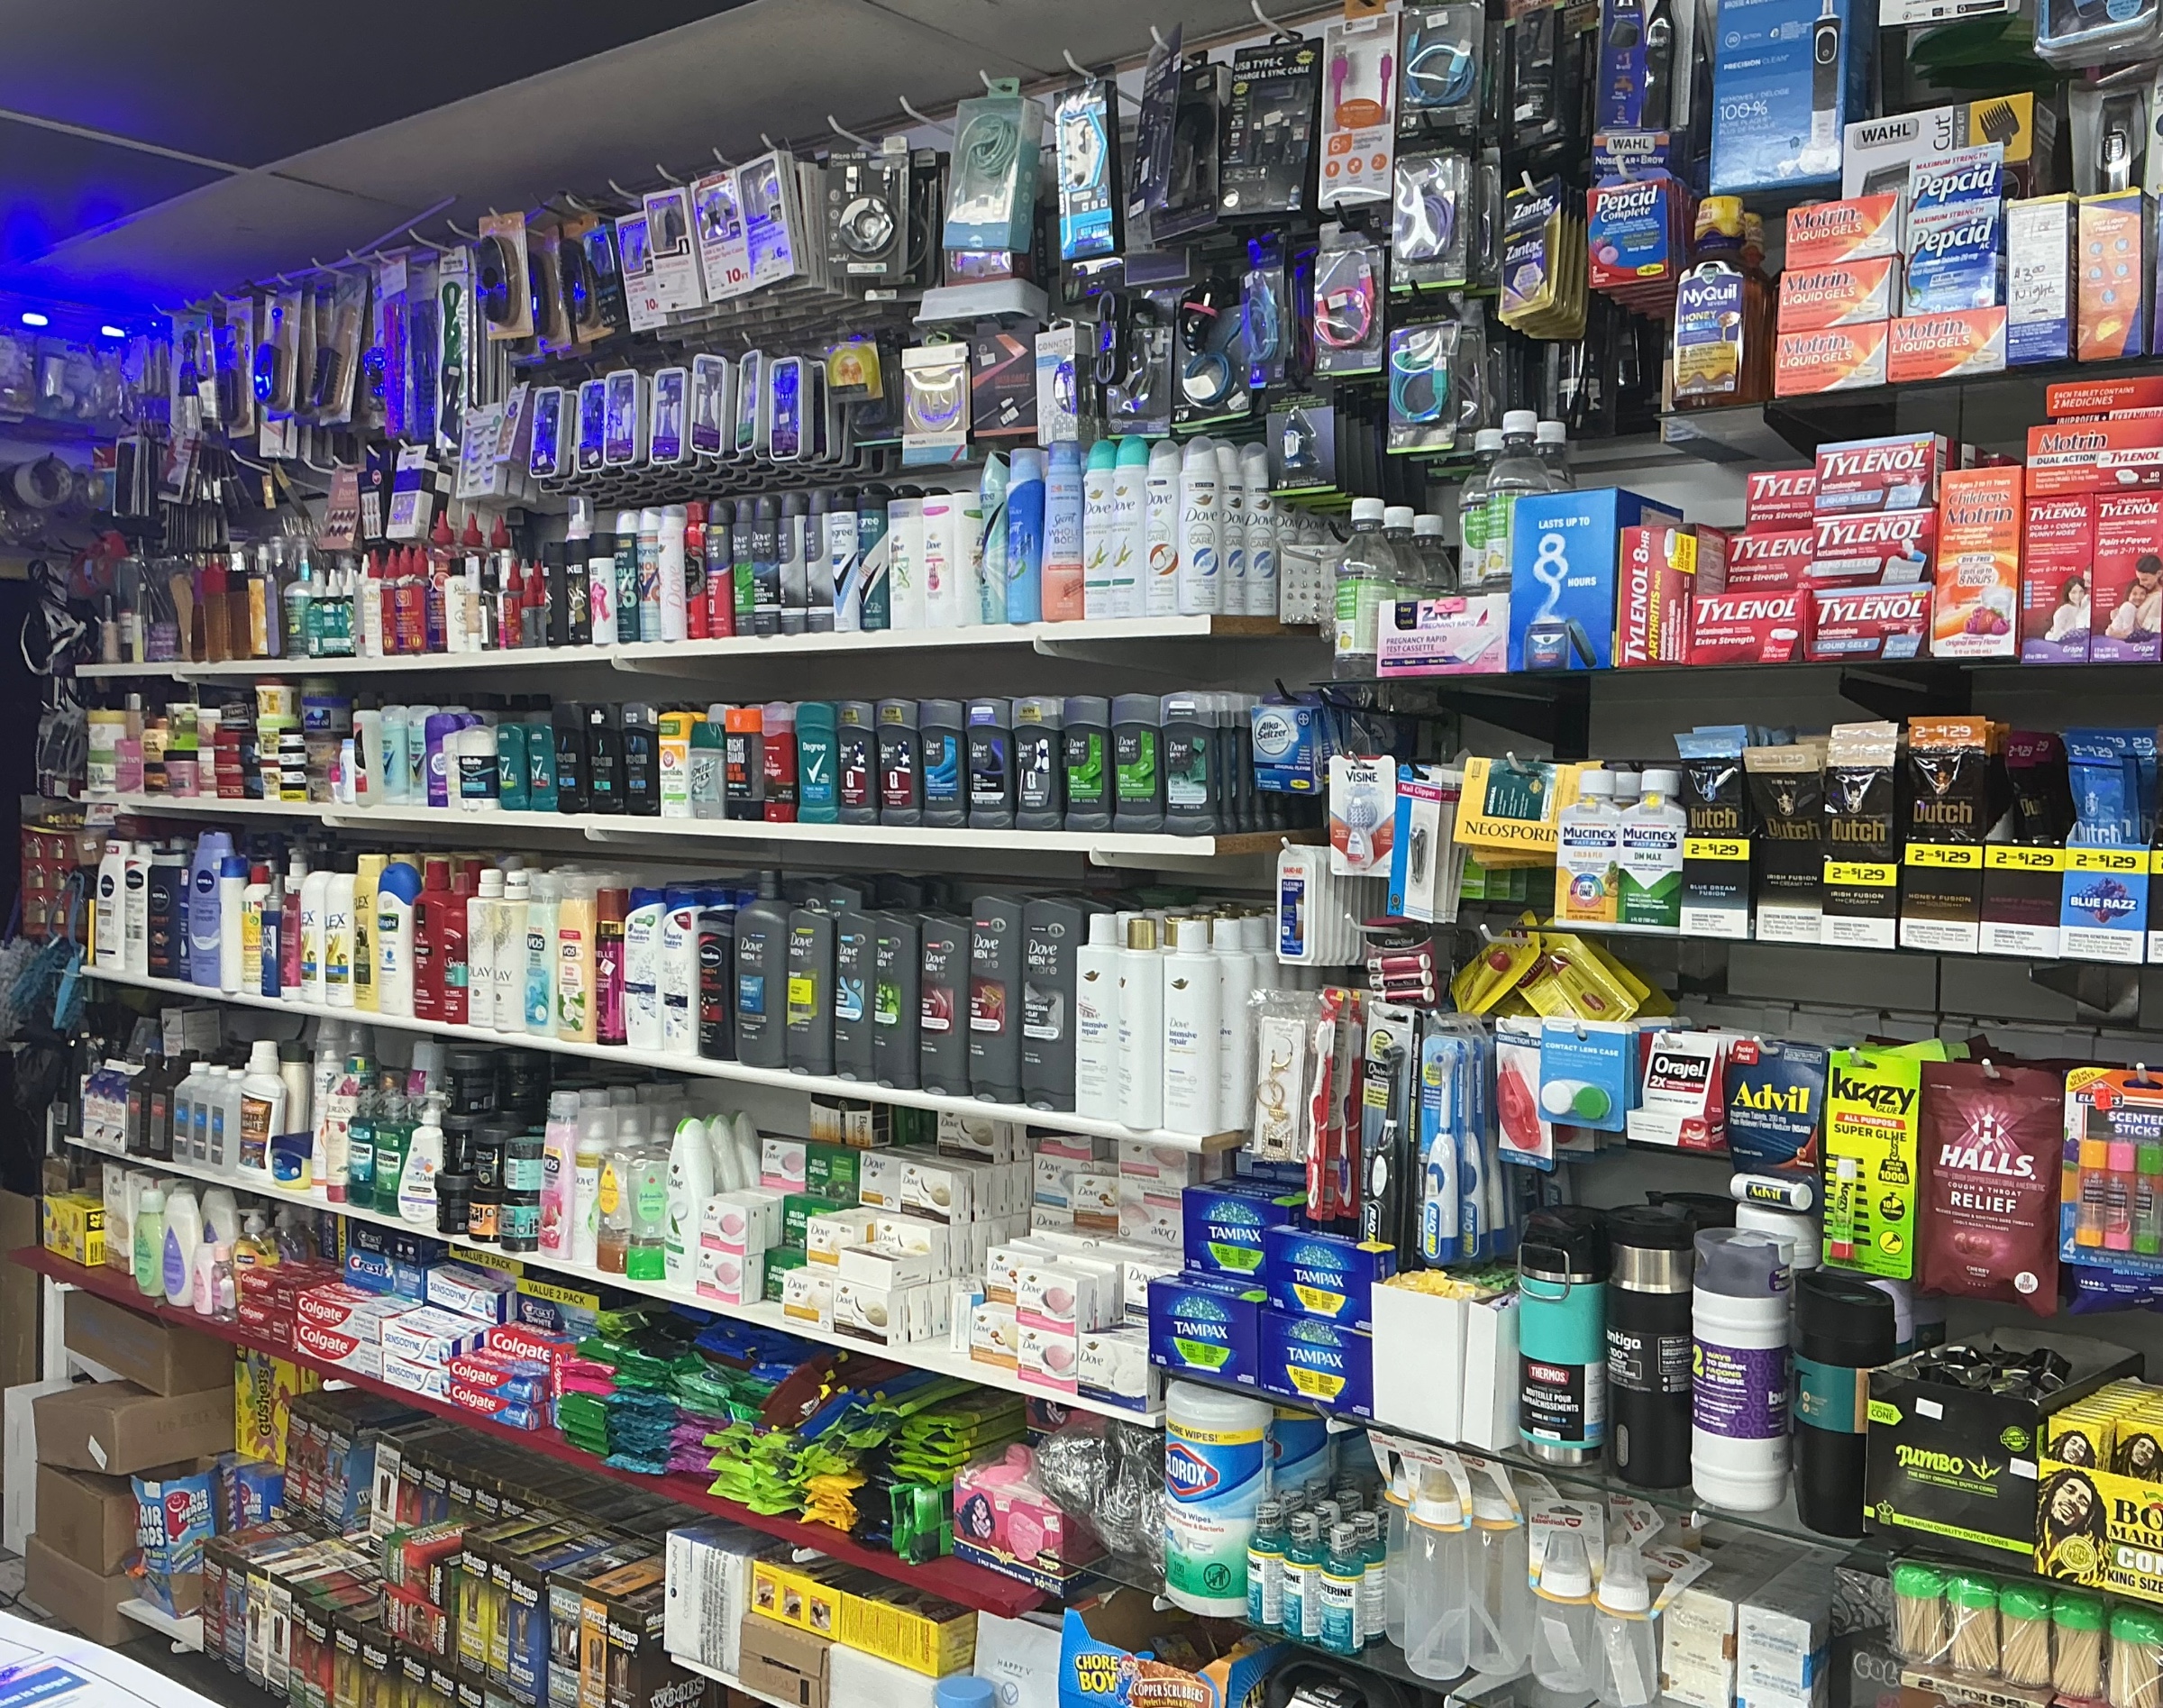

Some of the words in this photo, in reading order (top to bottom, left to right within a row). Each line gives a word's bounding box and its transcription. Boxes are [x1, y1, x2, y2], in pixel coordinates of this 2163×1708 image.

[1234, 71, 1261, 82] CHARGE
[1269, 68, 1286, 78] SYNC
[1287, 65, 1310, 76] CABLE
[1235, 60, 1254, 72] USB
[1255, 57, 1283, 70] TYPE-C
[1723, 59, 1761, 71] PRECISION
[1719, 100, 1768, 122] 100%
[1862, 124, 1911, 142] WAHL
[1612, 138, 1649, 151] WAHL
[830, 152, 851, 161] Micro
[852, 151, 866, 160] USB
[1916, 159, 1951, 171] MAXIMUM
[1952, 151, 1988, 165] STRENGTH
[1912, 162, 1997, 200] Pepcid
[1595, 185, 1657, 213] Pepcid
[1983, 187, 1994, 196] AC
[1512, 194, 1555, 221] Zantac
[1600, 206, 1651, 224] Complete
[1788, 206, 1856, 232] Motrin
[1788, 226, 1830, 244] LIQUID
[1830, 222, 1863, 236] GELS
[1910, 216, 1992, 257] Pepcid
[1505, 239, 1544, 262] Zantac
[1784, 269, 1848, 295] Motrin
[1683, 284, 1739, 307] NyQuil
[1782, 289, 1824, 307] LIQUID
[1824, 285, 1857, 300] GELS
[1681, 310, 1718, 324] HONEY
[1893, 317, 1964, 343] Motrin
[1037, 335, 1073, 352] CONNECT
[1780, 333, 1846, 358] Motrin
[1778, 352, 1821, 370] LIQUID
[1821, 349, 1853, 364] GELS
[2053, 390, 2072, 400] EACH
[2073, 388, 2098, 398] TABLET
[2099, 386, 2135, 397] CONTAINS
[2052, 399, 2059, 409] 2
[2060, 396, 2114, 409] MEDICINES
[2038, 430, 2109, 455] Motrin
[1821, 449, 1927, 481] TYLENOL
[2036, 455, 2061, 466] DUAL
[2061, 453, 2097, 463] ACTION
[2110, 451, 2161, 465] TYLENOL
[1185, 508, 1218, 523] Dove
[1944, 505, 2015, 527] Motrin
[2029, 506, 2088, 523] TYLENOL
[2098, 502, 2160, 519] TYLENOL
[1538, 519, 1565, 531] LASTS
[1565, 517, 1577, 528] UP
[1578, 516, 1590, 527] TO
[1816, 518, 1924, 551] TYLENOL
[1567, 576, 1597, 589] HOURS
[1729, 574, 1751, 584] Extra
[1752, 571, 1789, 582] Strength
[1958, 576, 1967, 586] 8
[1967, 574, 1992, 586] hours
[1624, 565, 1649, 663] TYLENOL
[1695, 598, 1797, 625] TYLENOL
[1816, 594, 1924, 625] TYLENOL
[1647, 589, 1661, 661] ARTHRITIS
[1386, 636, 1424, 647] PREGNANCY
[1425, 634, 1447, 644] RAPID
[1386, 644, 1404, 653] TEST
[1405, 642, 1436, 653] CASSETTE
[1345, 770, 1379, 783] VISINE
[1401, 782, 1415, 794] Nail
[1416, 785, 1437, 799] Clipper
[1913, 799, 1974, 824] Dutch
[1563, 826, 1617, 841] Mucinex
[1623, 827, 1677, 843] Mucinex
[1831, 818, 1886, 843] Dutch
[1634, 851, 1645, 862] DM
[1646, 851, 1663, 863] MAX
[1691, 844, 1701, 854] 2
[1914, 850, 1925, 862] 2
[2076, 854, 2087, 866] 2
[1766, 873, 1787, 881] IRISH
[1788, 874, 1819, 882] FUSION
[1689, 883, 1708, 891] BLUE
[1710, 884, 1737, 892] DREAM
[1699, 890, 1726, 898] FUSION
[1830, 891, 1852, 899] IRISH
[1853, 891, 1885, 900] FUSION
[1908, 892, 1937, 901] HONEY
[1939, 893, 1972, 903] FUSION
[2070, 895, 2101, 909] BLUE
[2104, 898, 2138, 910] RAZZ
[739, 936, 763, 953] Dove
[1029, 939, 1058, 956] Dove
[1028, 955, 1046, 965] MEN
[1497, 1033, 1530, 1046] CORRECTION
[1530, 1036, 1542, 1046] TAP
[1545, 1041, 1578, 1055] CONTACT
[1579, 1046, 1598, 1056] LENS
[1599, 1047, 1620, 1057] CASE
[1736, 1053, 1751, 1063] Pack
[1655, 1056, 1707, 1080] Orajel
[1649, 1074, 1667, 1089] 2X
[1729, 1081, 1812, 1115] Advil
[1876, 1103, 1901, 1115] GLUE
[1843, 1114, 1857, 1124] ALL
[1858, 1116, 1898, 1128] PURPOSE
[2114, 1123, 2160, 1137] STICKS
[1833, 1123, 1874, 1138] SUPER
[1876, 1127, 1908, 1143] GLUE
[1748, 1185, 1783, 1201] Advil
[1948, 1182, 1976, 1192] COUGH
[1986, 1187, 2022, 1197] THROAT
[1949, 1191, 2018, 1215] RELIEF
[1208, 1225, 1263, 1244] TAMPAX
[348, 1255, 385, 1276] Crest
[460, 1250, 483, 1264] VALUE
[491, 1258, 512, 1272] PACK
[241, 1271, 269, 1291] Colgate
[1292, 1267, 1345, 1290] TAMPAX
[429, 1281, 469, 1303] SENSODYNE
[526, 1282, 552, 1296] VALUE
[563, 1290, 587, 1306] PACK
[297, 1295, 345, 1324] Colgate
[1173, 1320, 1229, 1340] TAMPAX
[298, 1325, 351, 1355] Colgate
[384, 1332, 422, 1353] SENSODYNE
[491, 1331, 552, 1362] Colgate
[1286, 1346, 1344, 1369] TAMPAX
[1705, 1358, 1718, 1366] TO
[1718, 1360, 1748, 1372] DRINK
[1706, 1351, 1731, 1362] WAYS
[385, 1365, 423, 1384] SENSODYNE
[451, 1360, 499, 1387] Colgate
[1705, 1373, 1716, 1383] DE
[1717, 1376, 1746, 1386] BOIRE
[258, 1365, 271, 1438] Gushers
[452, 1385, 498, 1411] Colgate
[1554, 1393, 1573, 1404] POUR
[1870, 1408, 1894, 1422] CONE
[1185, 1425, 1220, 1443] WIPES!
[188, 1489, 208, 1505] AIR
[139, 1503, 163, 1528] AIR
[178, 1499, 209, 1523] HEADS
[1187, 1511, 1212, 1525] Wipes
[1903, 1517, 1934, 1530] PREMIUM
[1934, 1523, 1962, 1537] QUALITY
[1963, 1529, 1986, 1542] DUTCH
[1986, 1535, 2010, 1548] CONES
[2106, 1569, 2136, 1587] KING
[2139, 1576, 2163, 1594] SIZE
[1074, 1654, 1119, 1674] CHORE
[1079, 1669, 1117, 1693] BOY
[1133, 1681, 1164, 1698] COPPER
[1163, 1683, 1205, 1703] SCRUBBERS
[1960, 1686, 1989, 1705] FOR
